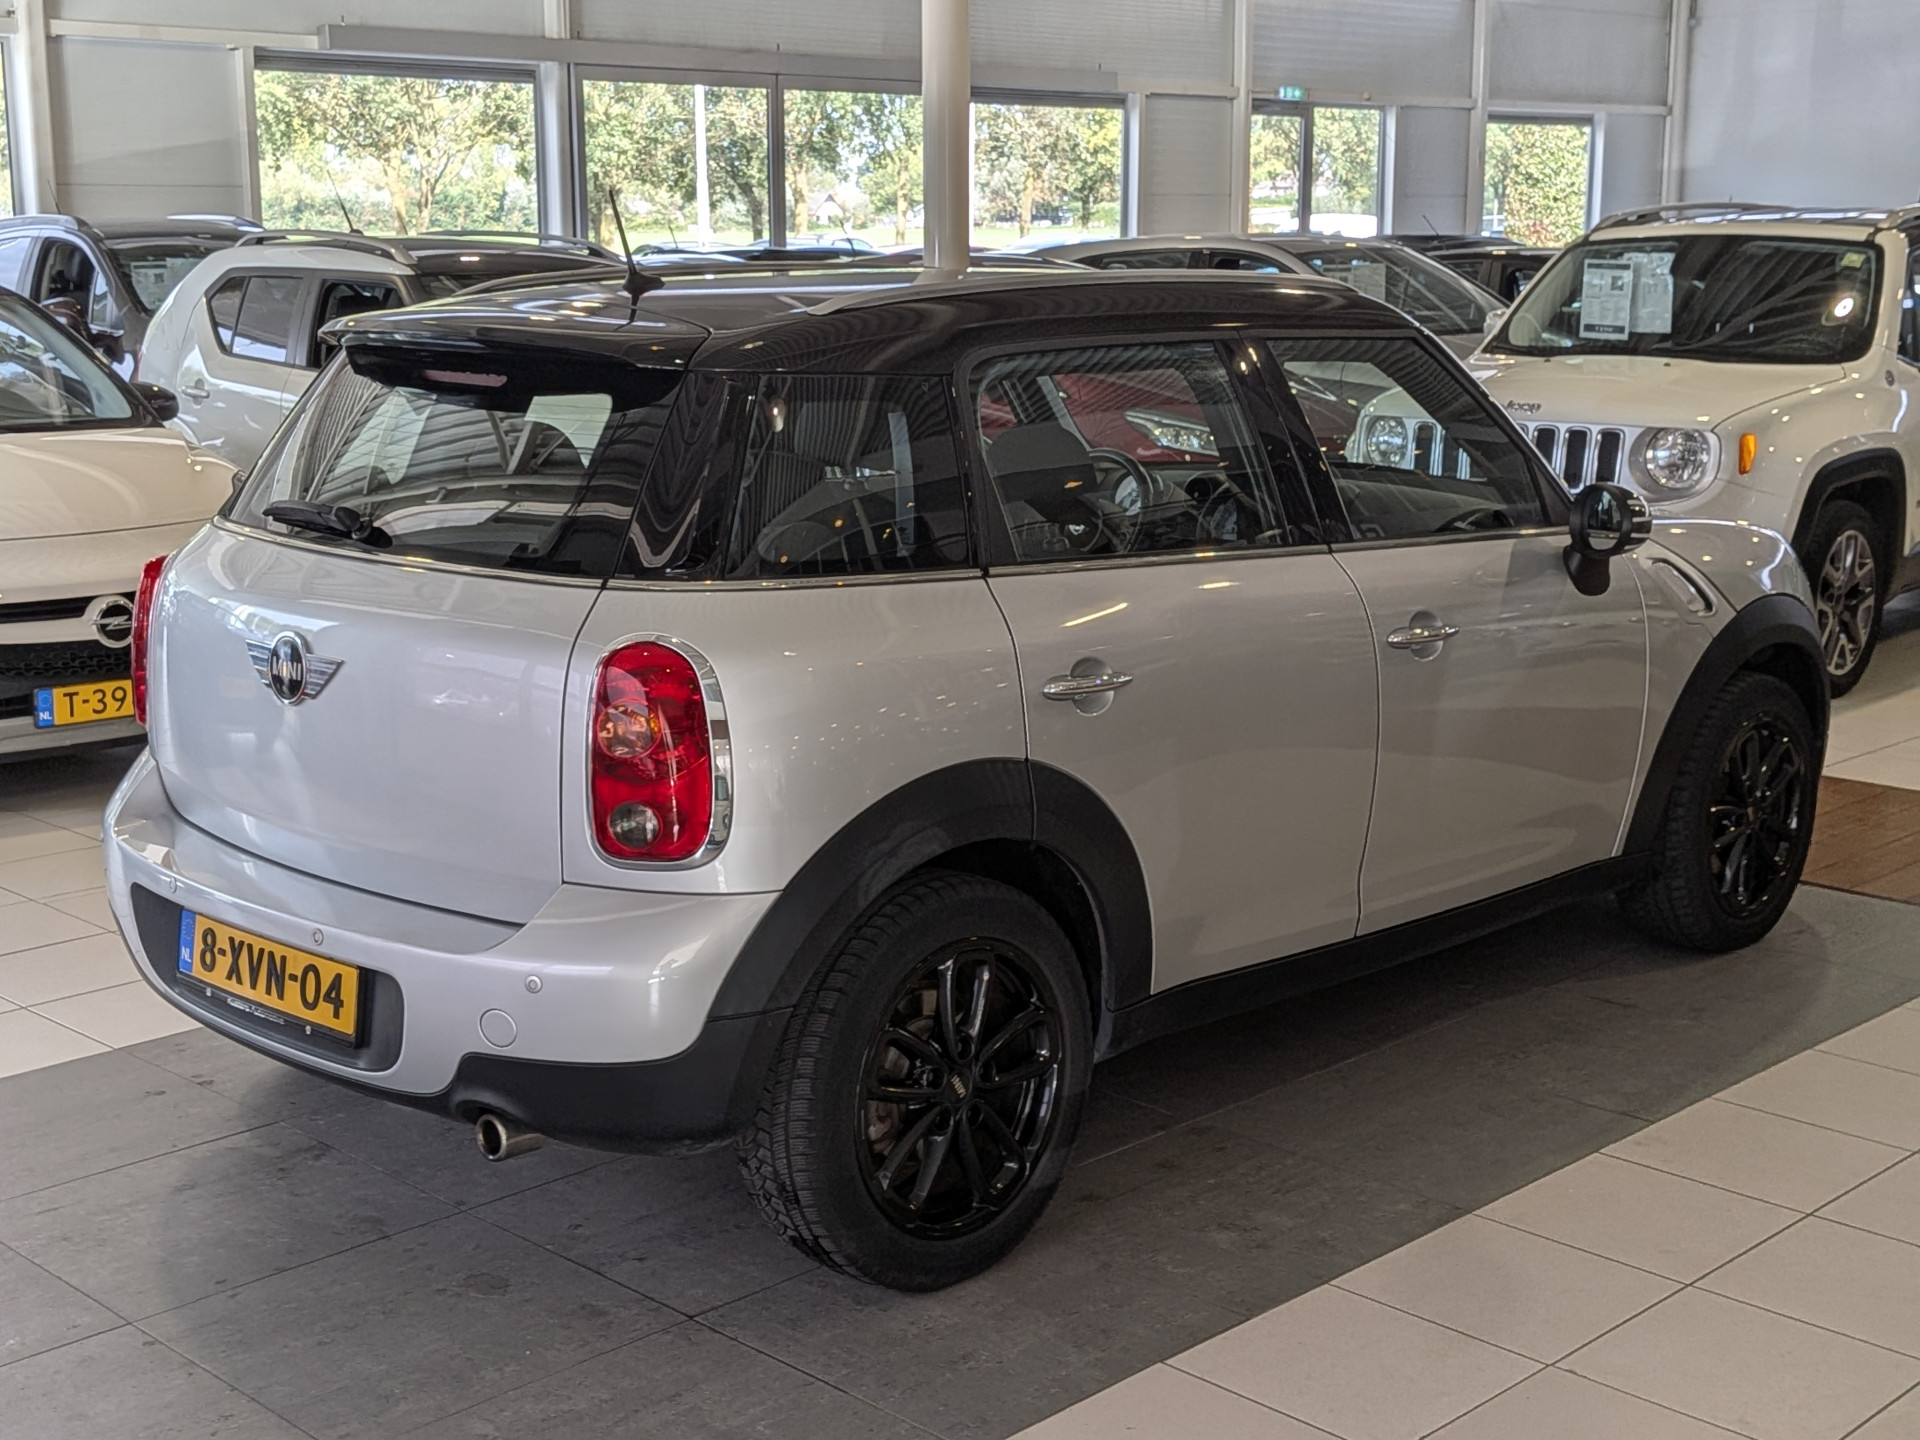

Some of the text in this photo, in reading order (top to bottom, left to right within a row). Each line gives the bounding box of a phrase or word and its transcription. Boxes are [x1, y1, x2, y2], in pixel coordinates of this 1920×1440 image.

[272, 655, 302, 681] MINI
[40, 686, 127, 720] NL T-39
[182, 946, 191, 963] NL
[200, 927, 344, 1020] 8-XVN-04
